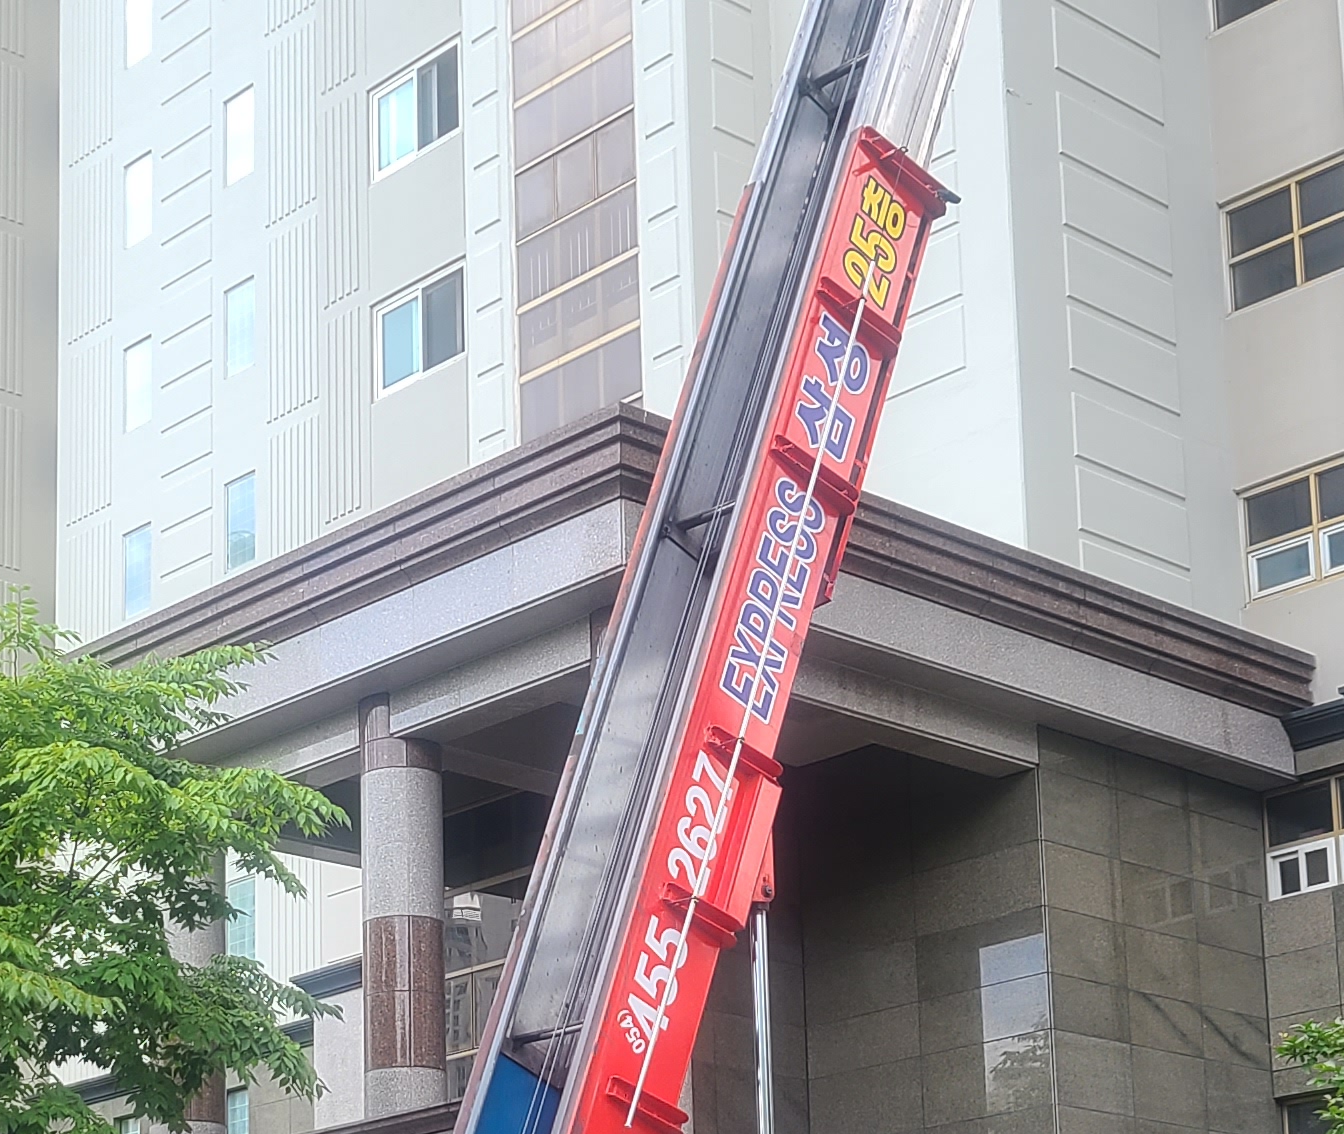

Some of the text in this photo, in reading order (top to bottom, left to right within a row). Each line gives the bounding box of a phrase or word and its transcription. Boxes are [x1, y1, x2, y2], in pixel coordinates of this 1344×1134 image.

[843, 174, 908, 311] 25층
[795, 312, 870, 466] 삼성
[718, 478, 826, 724] EXPRESS
[626, 915, 690, 1042] 455
[667, 749, 740, 897] 2627
